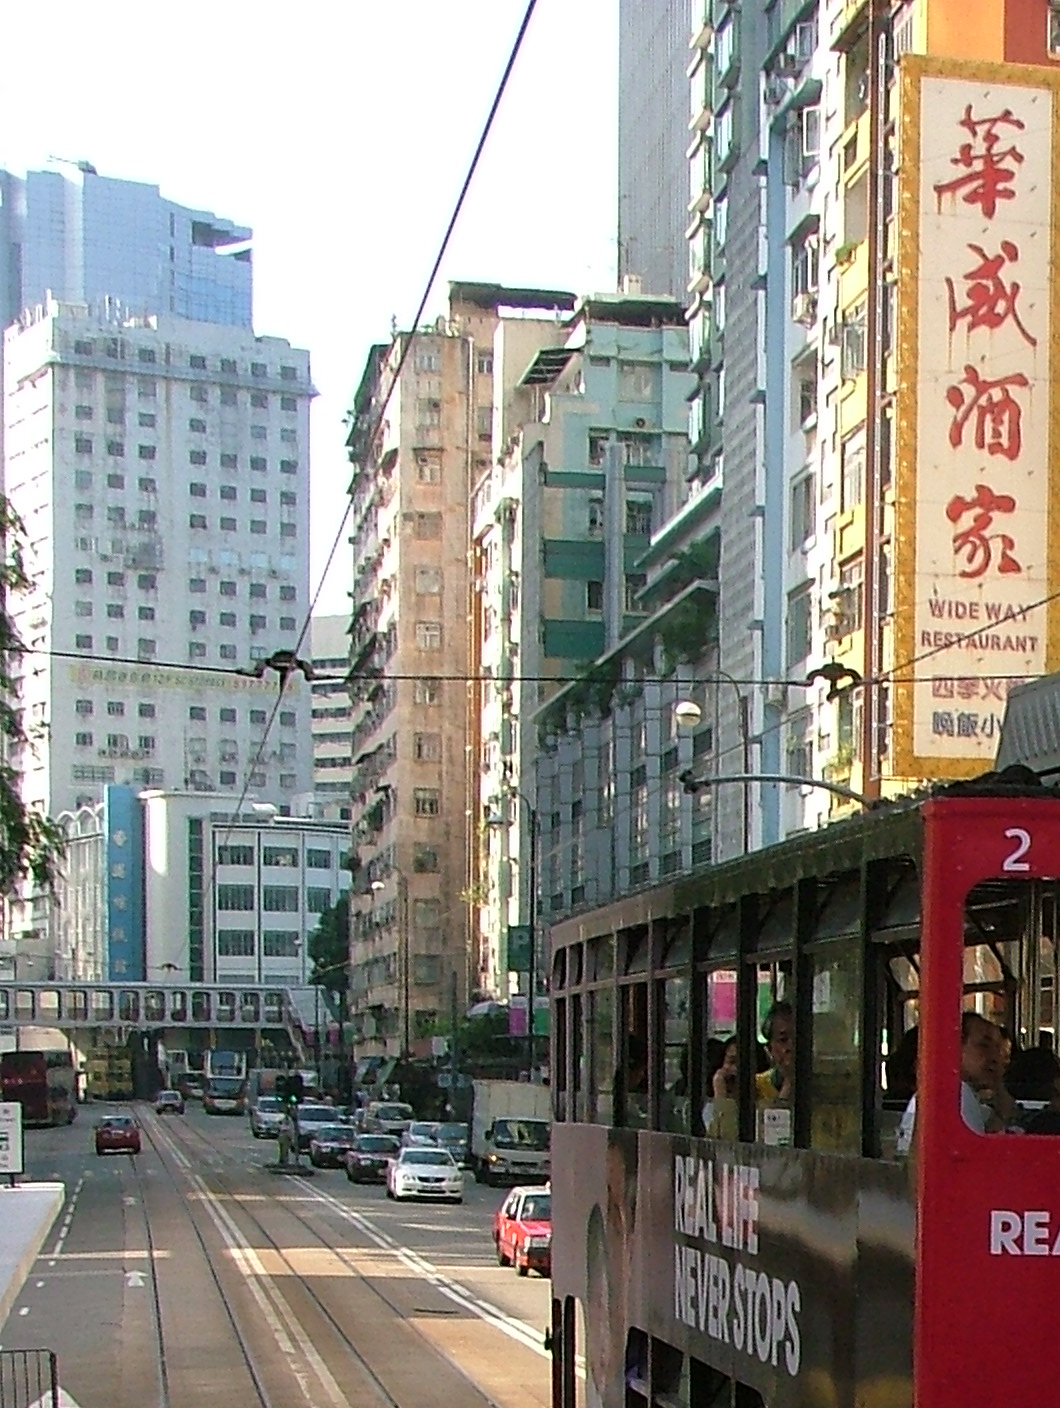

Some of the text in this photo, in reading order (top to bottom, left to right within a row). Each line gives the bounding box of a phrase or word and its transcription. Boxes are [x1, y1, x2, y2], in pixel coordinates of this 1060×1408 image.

[934, 104, 1037, 578] 華威酒家
[929, 598, 1031, 623] WIDE WAY
[921, 629, 1039, 653] RESTAURANT
[932, 674, 1026, 701] 四季火
[1003, 827, 1031, 873] 2
[675, 1155, 760, 1256] REAL LIFE
[675, 1244, 801, 1378] NEVER STOPS
